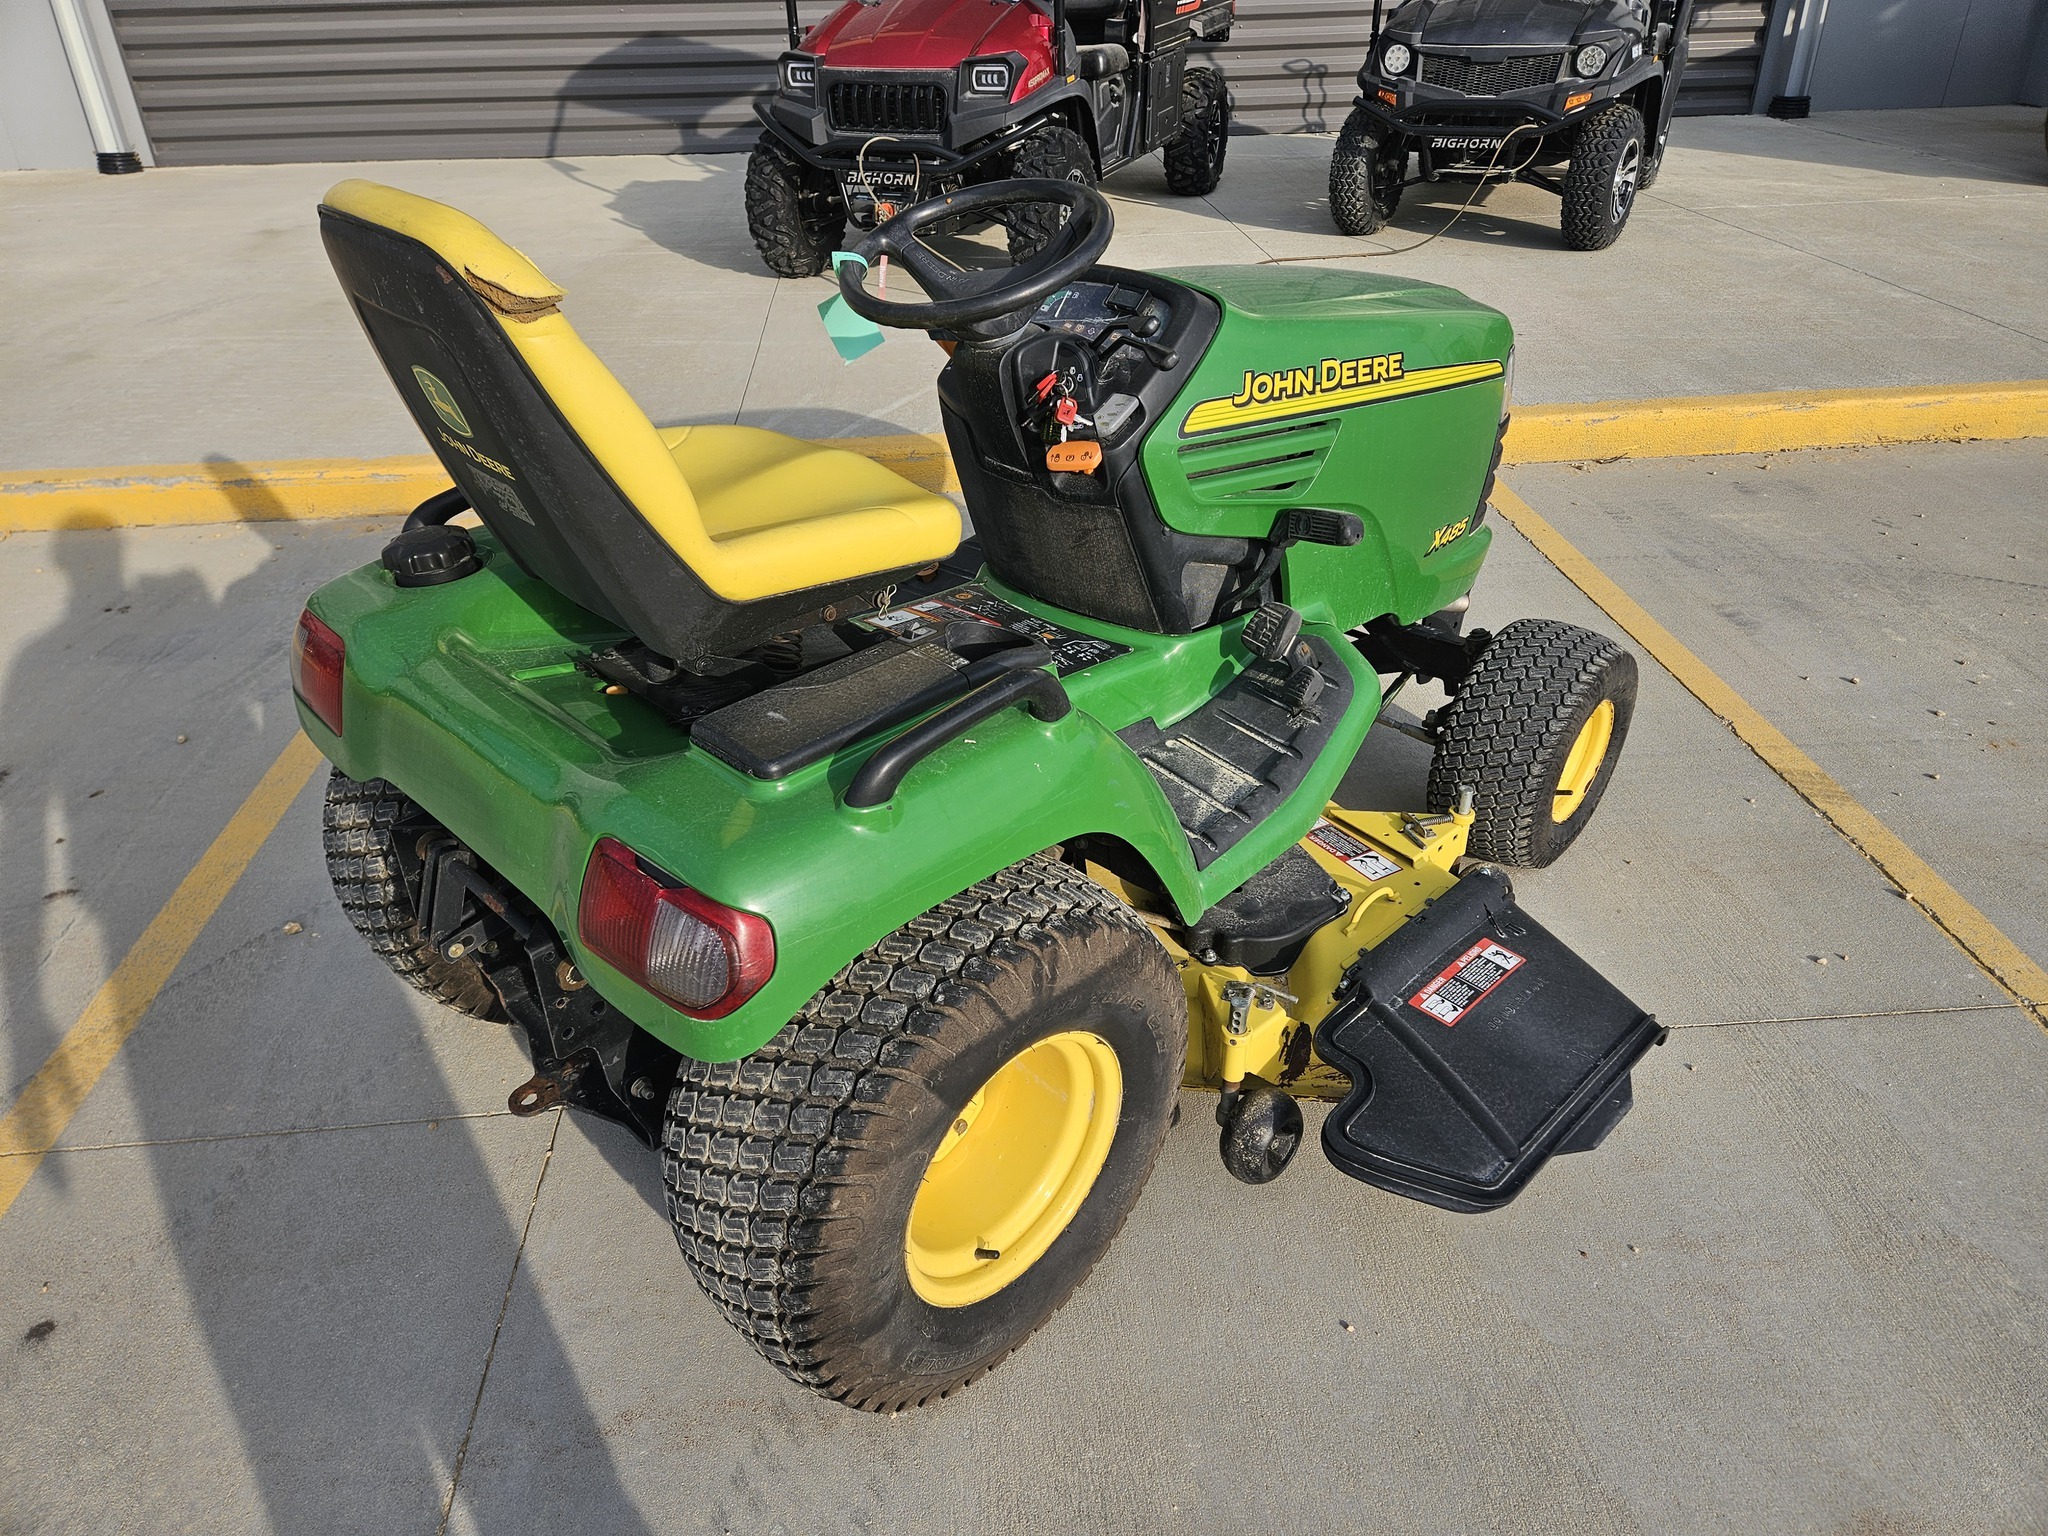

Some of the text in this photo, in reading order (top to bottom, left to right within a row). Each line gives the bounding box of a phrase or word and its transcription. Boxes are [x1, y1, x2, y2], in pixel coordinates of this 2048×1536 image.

[1431, 138, 1502, 149] BIGHORN
[847, 171, 915, 186] BIGHORN
[1233, 353, 1404, 406] JOHN DEERE
[437, 427, 516, 481] JOHN DEERE
[1424, 515, 1470, 557] X485
[1308, 835, 1338, 853] DANGER
[1423, 976, 1448, 999] DANGER
